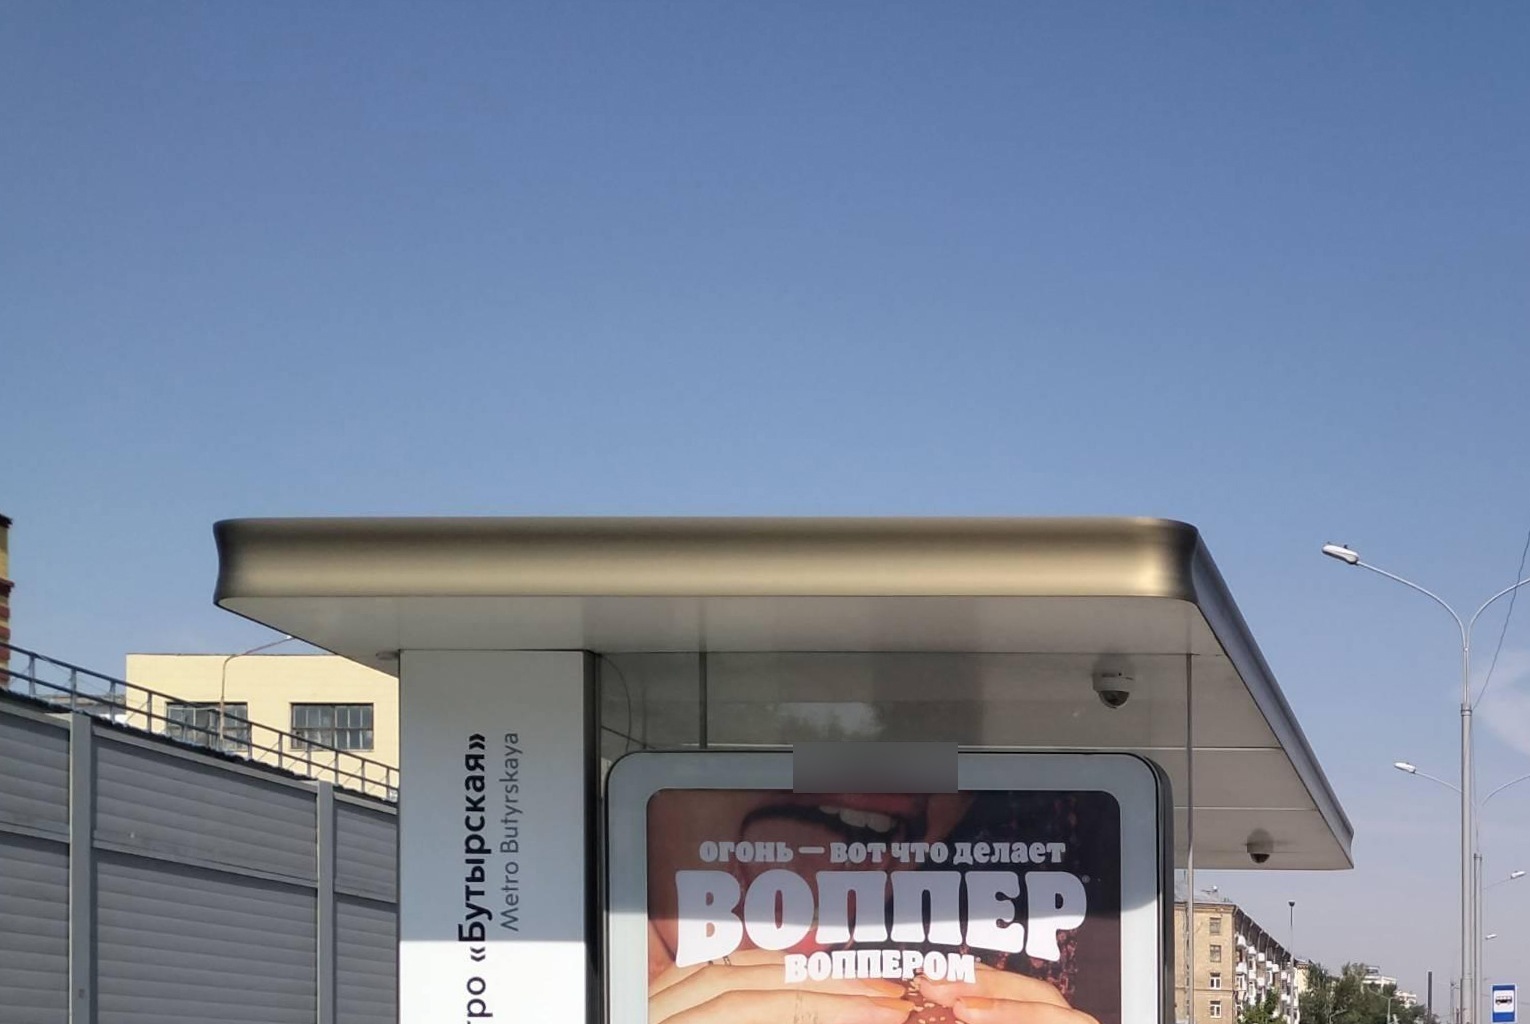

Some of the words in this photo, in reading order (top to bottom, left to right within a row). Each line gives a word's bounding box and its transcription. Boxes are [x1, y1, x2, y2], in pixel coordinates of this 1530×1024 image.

[500, 732, 523, 854] Butyrskaya
[458, 733, 493, 962] «Бутырская»
[699, 841, 794, 864] огонь
[830, 842, 887, 864] вот
[891, 842, 948, 863] что
[952, 842, 1066, 865] делает
[500, 860, 519, 932] Metro
[675, 870, 1088, 968] ВОППЕР
[784, 950, 977, 984] ВОППЕРОМ
